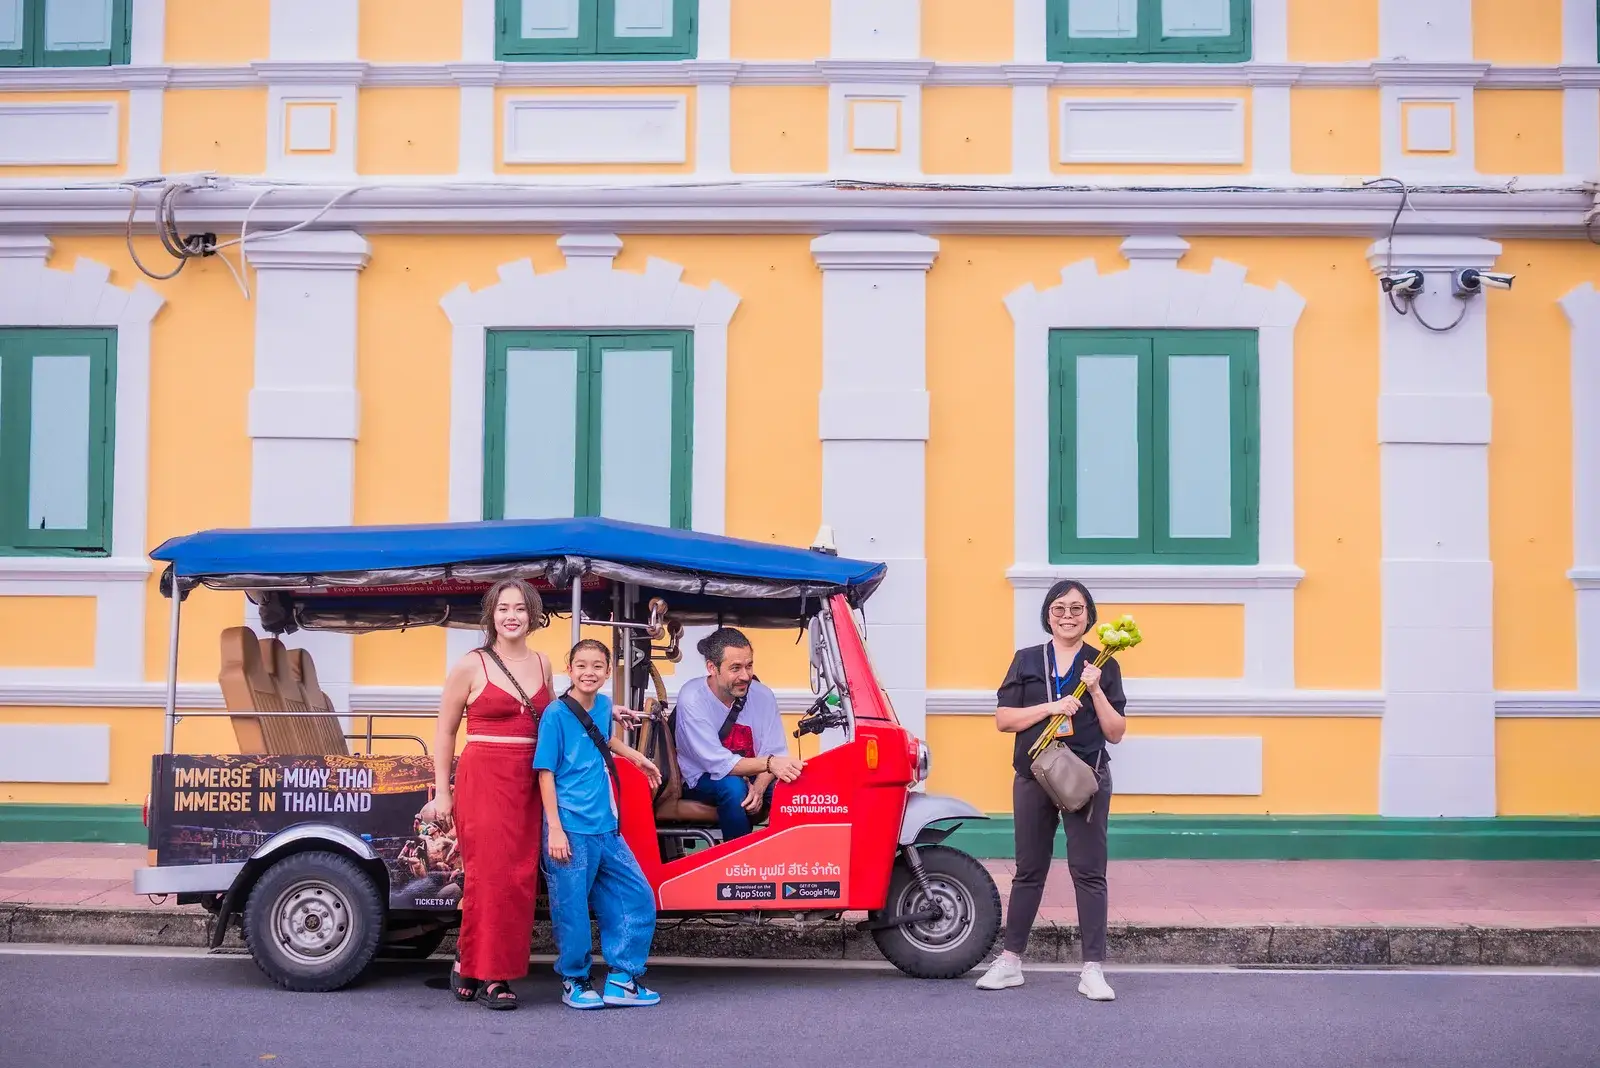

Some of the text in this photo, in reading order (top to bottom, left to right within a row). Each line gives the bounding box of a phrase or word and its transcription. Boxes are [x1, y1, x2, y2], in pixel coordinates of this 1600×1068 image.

[333, 586, 356, 595] Enjoy
[377, 584, 424, 593] attractions
[437, 582, 453, 592] just
[473, 583, 489, 592] pric
[175, 767, 372, 788] IMMERSE IN MUAY THAI
[174, 791, 372, 812] IMMERSE IN THAILAND
[810, 794, 839, 805] 2030
[780, 805, 848, 816] กรุงเทพมหานคร
[725, 862, 840, 881] บริษัท มูฟมี ฮีโร่ จำกัด
[735, 890, 771, 899] App Store
[799, 888, 837, 897] Google Play
[415, 898, 454, 906] TICKETS AT
